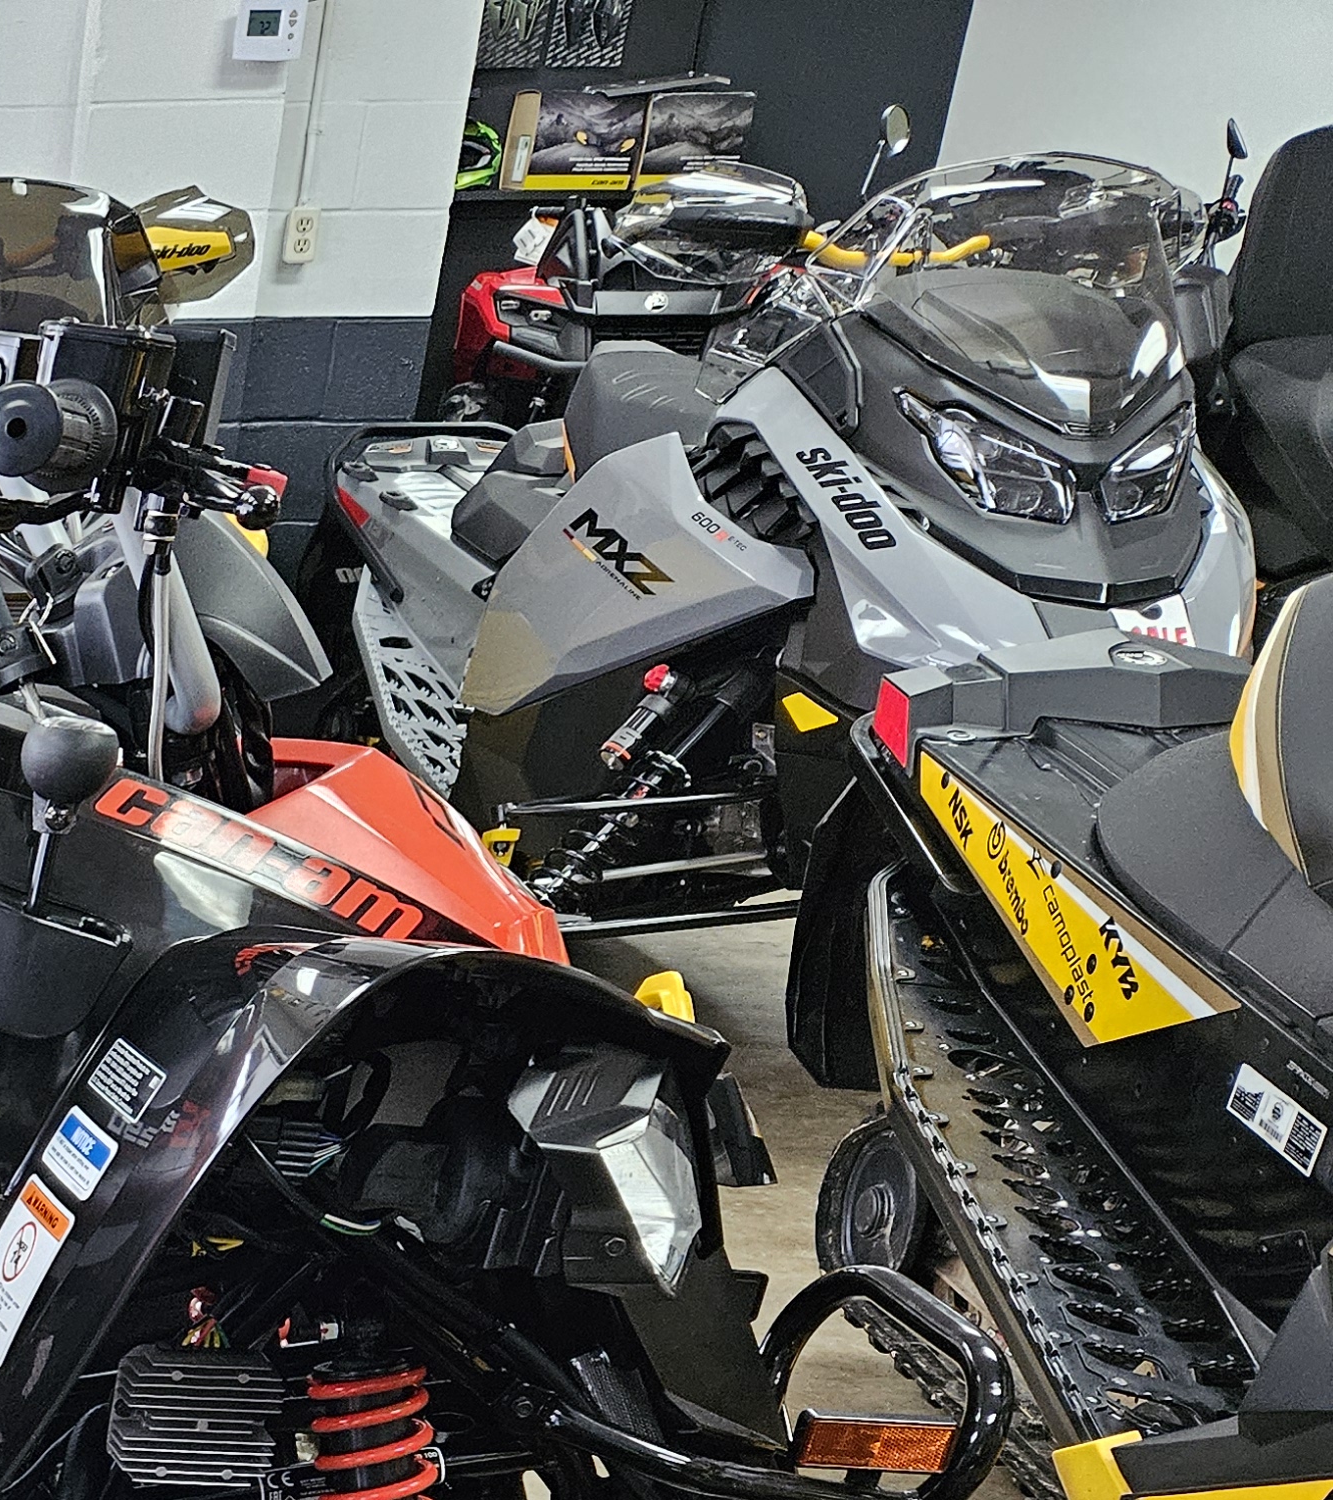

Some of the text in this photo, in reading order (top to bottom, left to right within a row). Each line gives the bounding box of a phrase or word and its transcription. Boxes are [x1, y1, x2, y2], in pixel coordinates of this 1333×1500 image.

[795, 445, 897, 551] ski-doo
[569, 507, 675, 596] MXZ
[595, 560, 642, 601] ADRENALINE
[94, 777, 423, 940] can-am
[948, 788, 973, 851] NSK
[997, 849, 1028, 936] brembo
[1042, 884, 1095, 1005] camoplast
[1099, 916, 1139, 1000] KYB
[70, 1126, 96, 1156] NOTICE
[32, 1195, 59, 1229] WARNING
